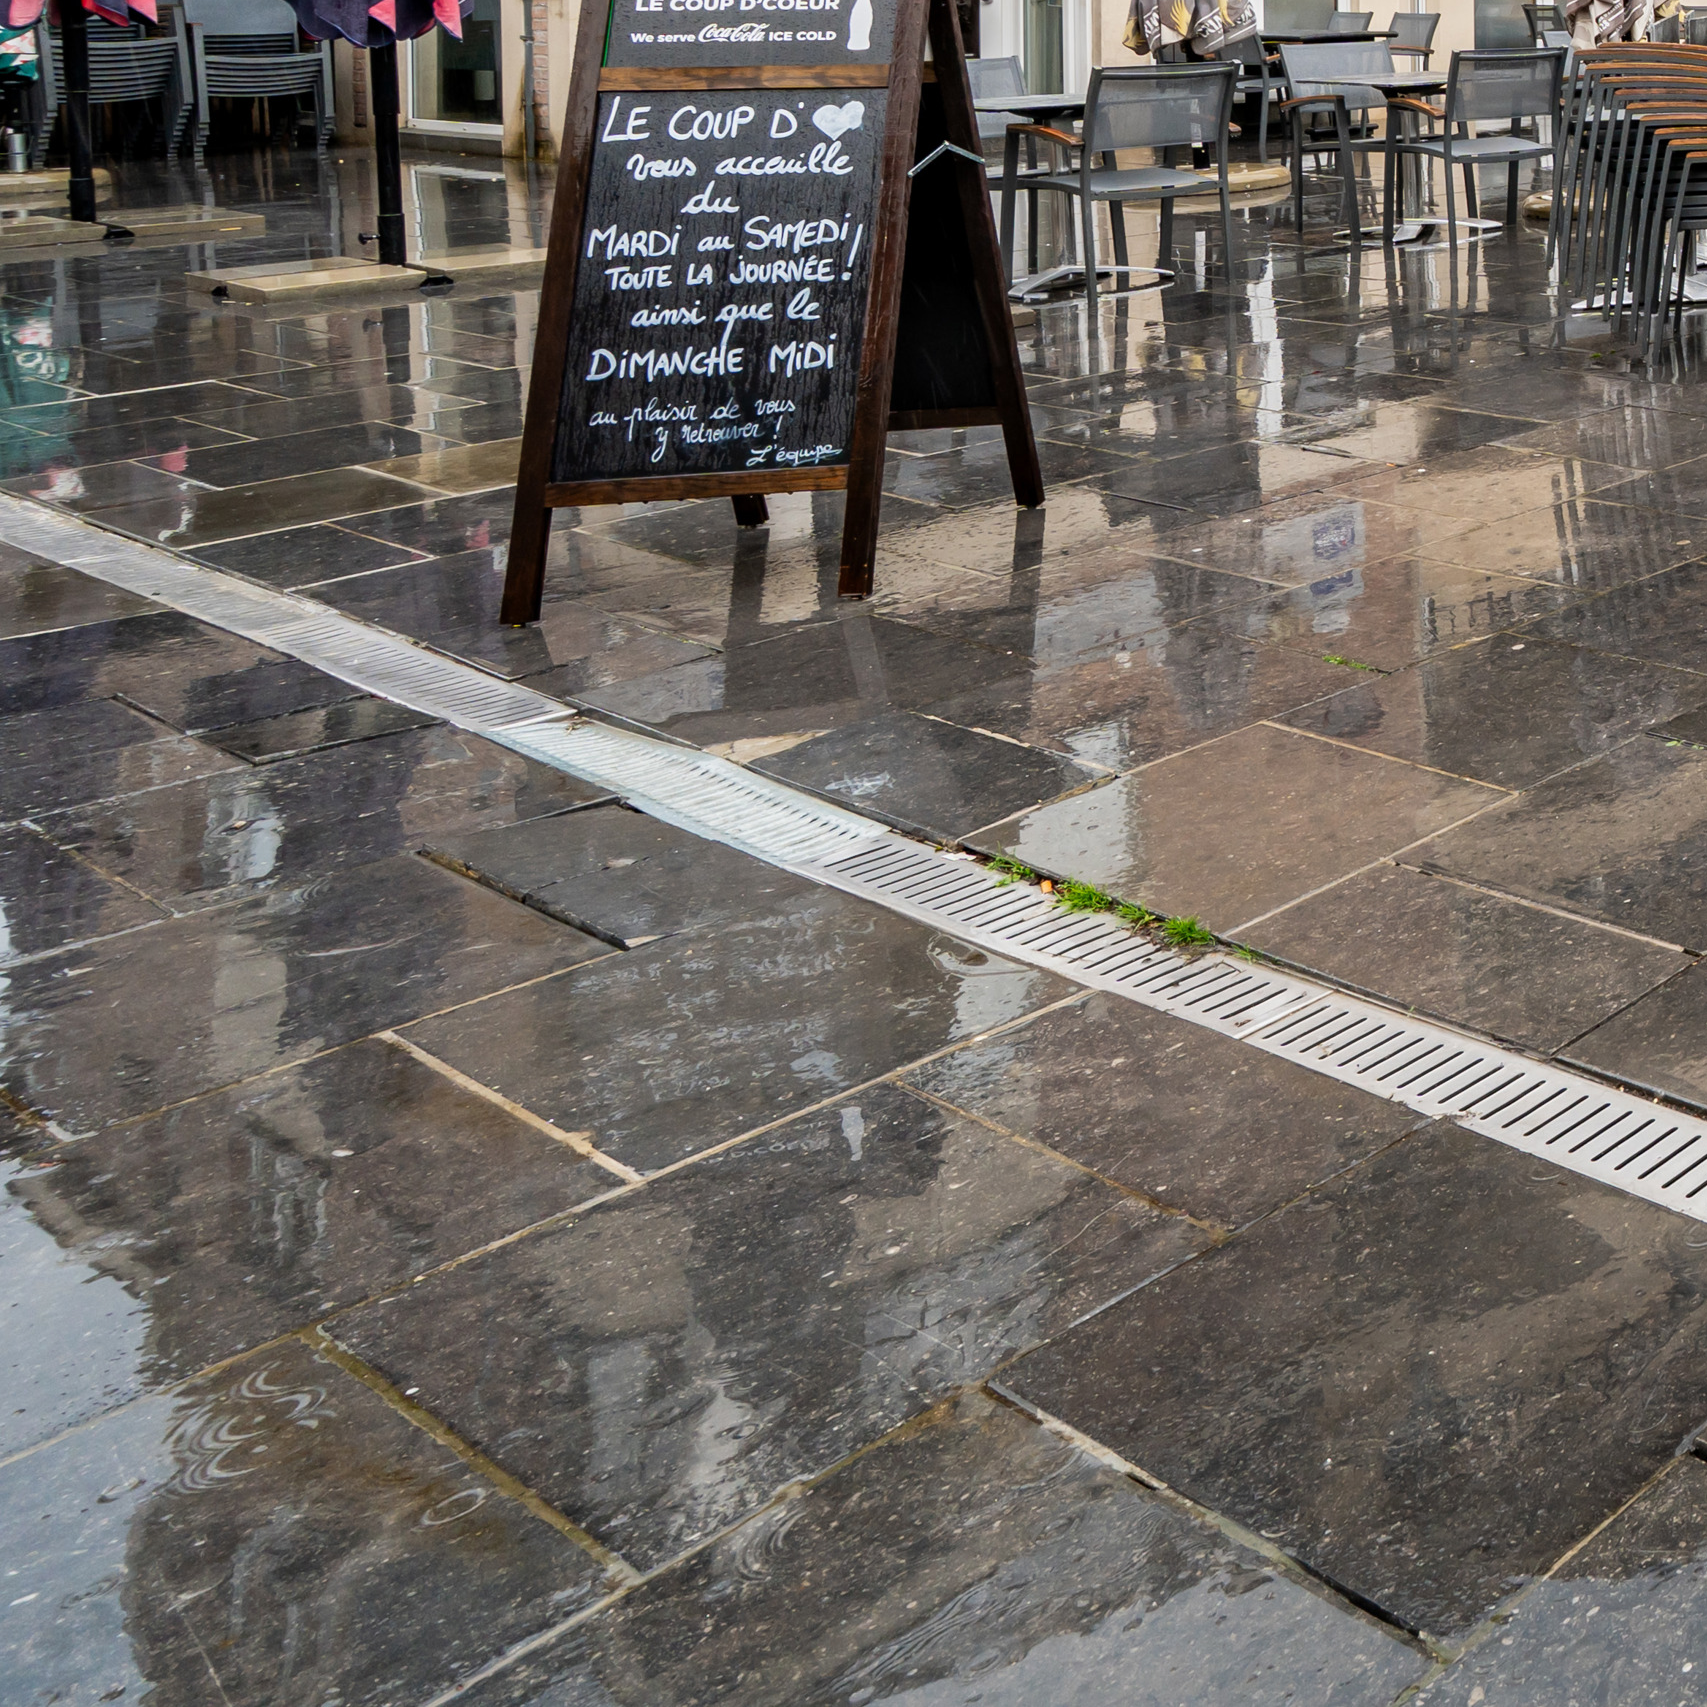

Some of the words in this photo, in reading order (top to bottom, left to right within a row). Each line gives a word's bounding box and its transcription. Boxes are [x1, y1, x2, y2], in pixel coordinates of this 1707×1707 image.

[631, 32, 654, 43] We
[657, 32, 696, 43] serve
[698, 22, 770, 43] Coca-Cola
[769, 30, 793, 42] ICE
[796, 30, 837, 42] COLD
[602, 96, 652, 143] LE
[668, 105, 756, 141] COUP
[681, 180, 740, 214] du
[697, 235, 735, 252] au
[604, 264, 673, 290] TOUTE
[686, 262, 713, 285] LA
[630, 300, 706, 327] ainsi
[714, 302, 774, 347] que
[786, 287, 822, 321] le
[589, 410, 618, 427] au
[623, 396, 699, 442] plaisir
[709, 397, 742, 420] de
[754, 398, 796, 416] vous
[680, 421, 766, 445] retrouver
